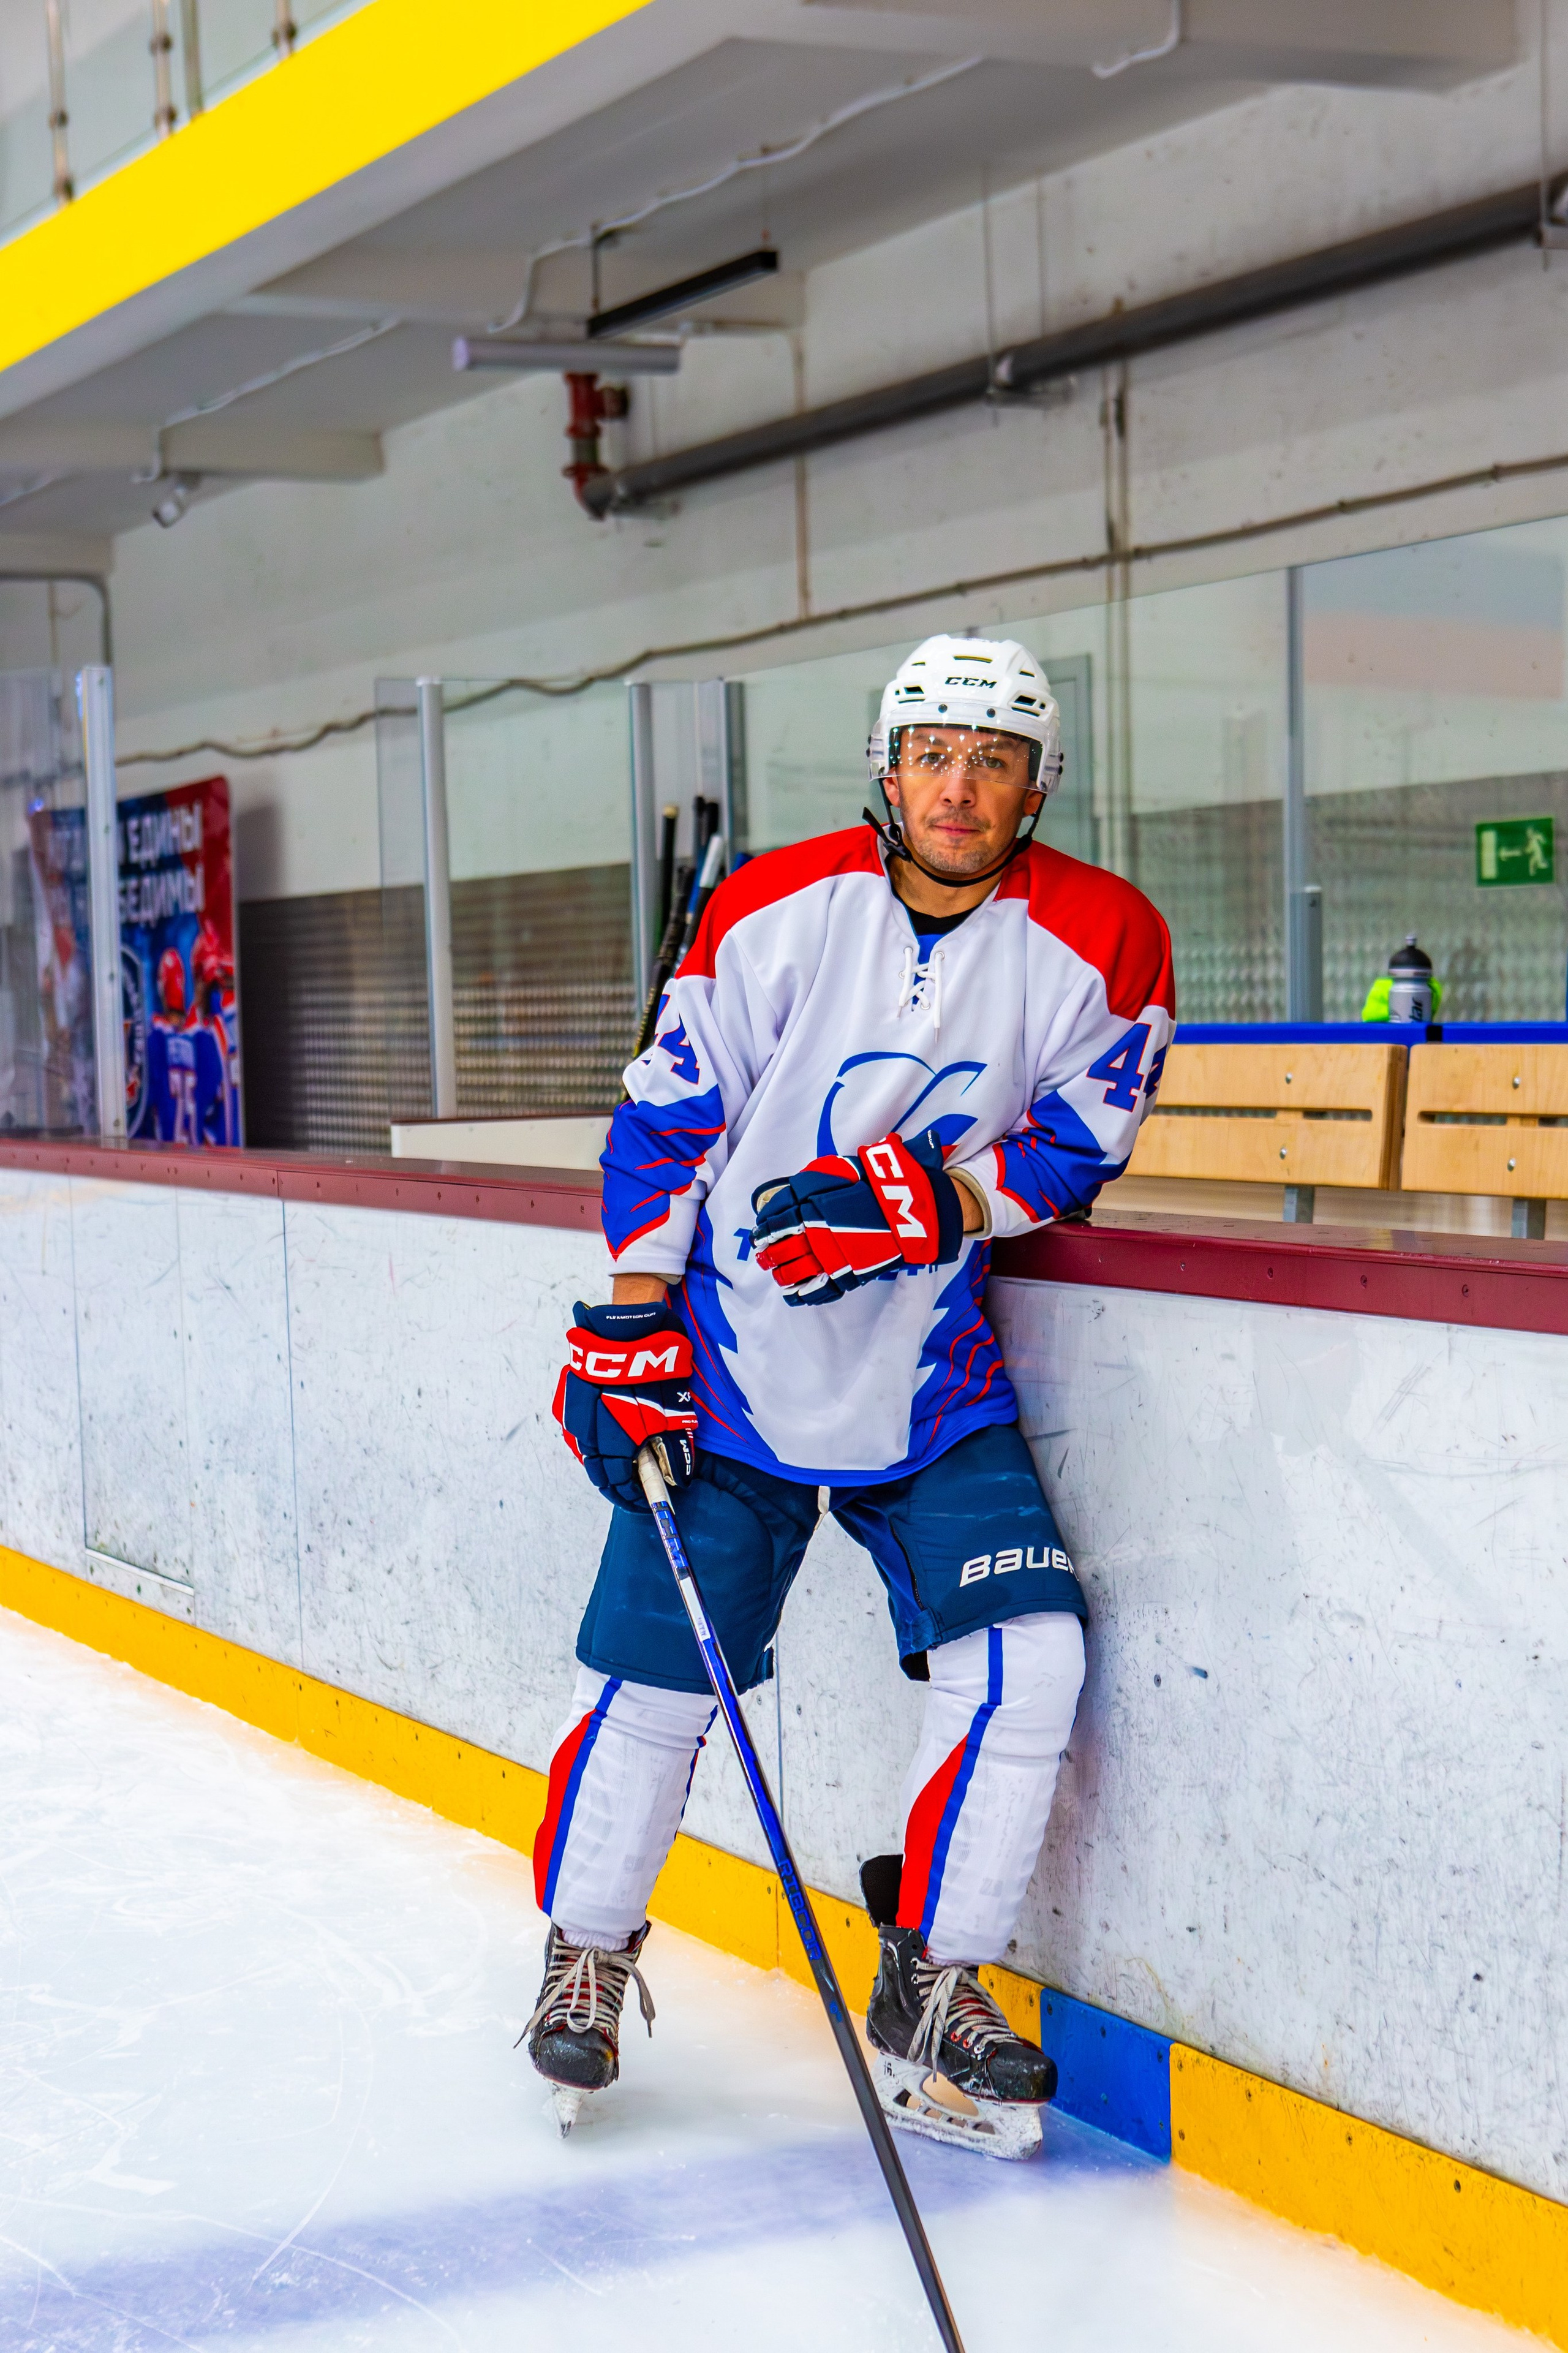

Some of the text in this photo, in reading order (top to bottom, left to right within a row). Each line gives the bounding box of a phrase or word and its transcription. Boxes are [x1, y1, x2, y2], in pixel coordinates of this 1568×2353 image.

[944, 676, 998, 689] CCM
[865, 1137, 927, 1238] CM
[569, 1342, 679, 1378] CCM
[679, 1440, 691, 1476] CCM
[777, 1859, 822, 1961] RIBCOR
